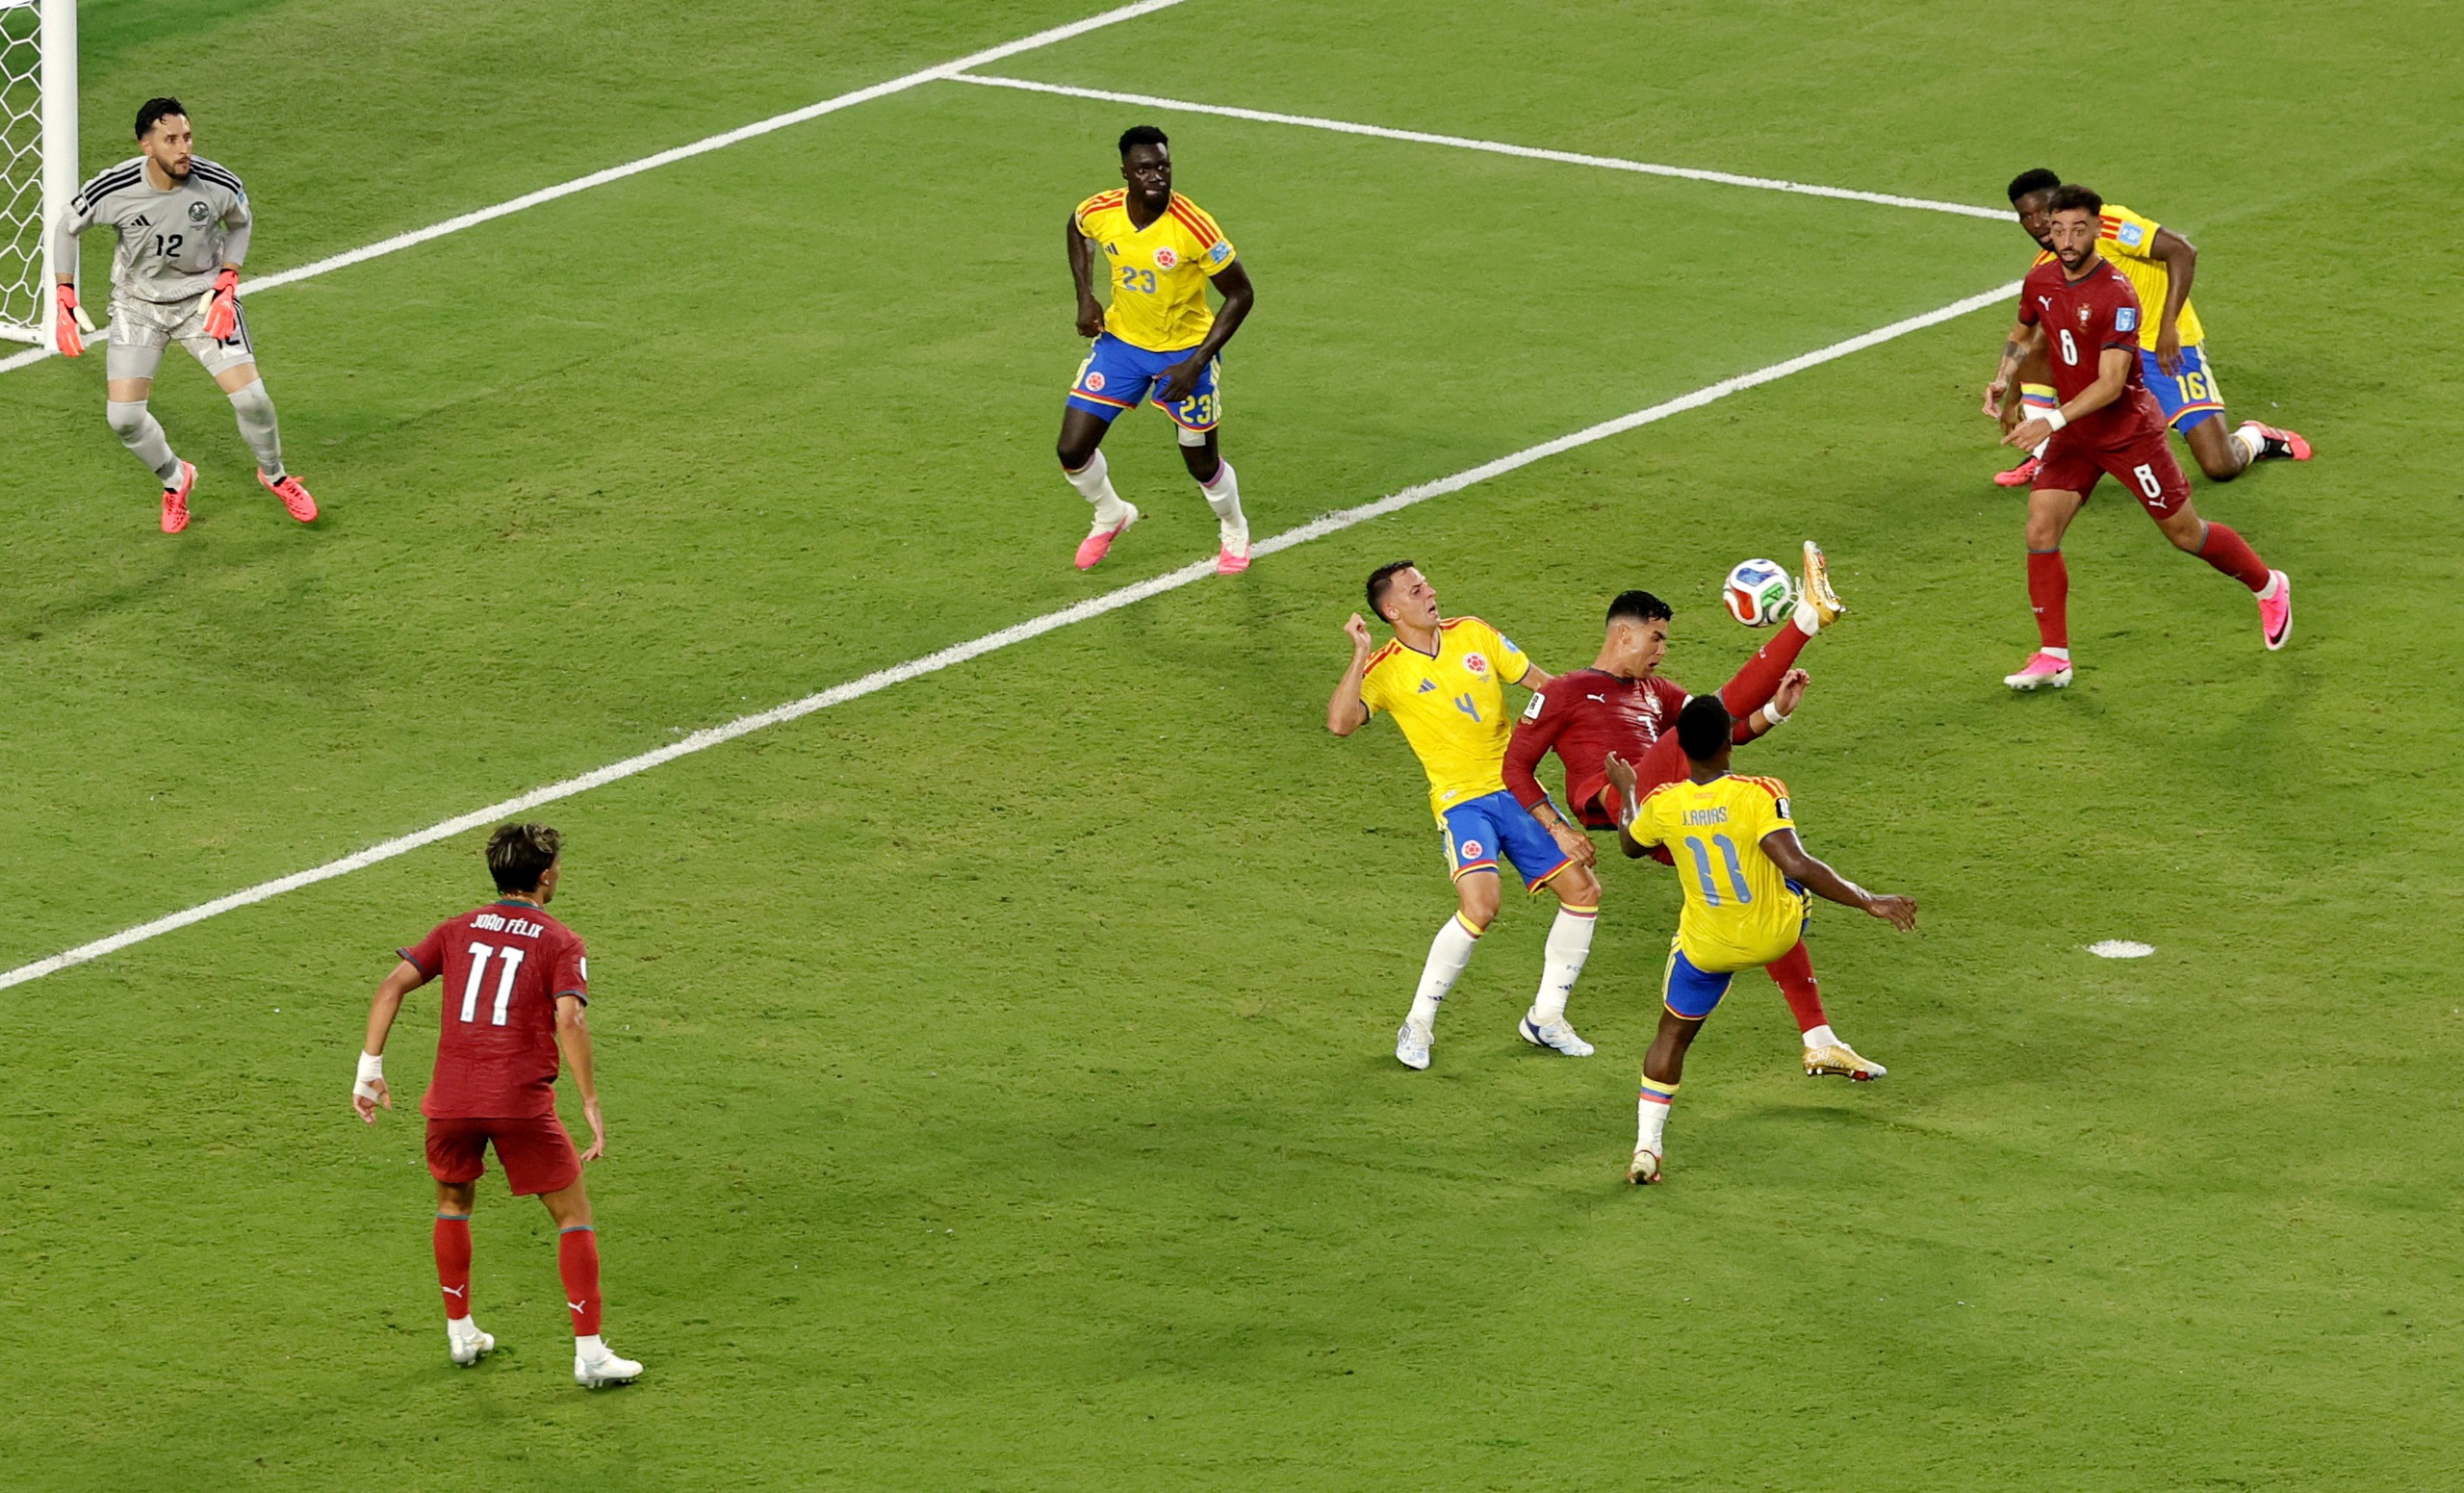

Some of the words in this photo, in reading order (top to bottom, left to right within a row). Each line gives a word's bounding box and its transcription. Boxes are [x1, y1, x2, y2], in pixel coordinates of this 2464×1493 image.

[156, 234, 183, 257] 12
[1123, 266, 1155, 294] 23
[2060, 328, 2078, 366] 8
[2176, 372, 2206, 403] 16
[1179, 395, 1211, 425] 23
[2133, 463, 2162, 499] 8
[1455, 693, 1480, 722] 4
[1637, 715, 1657, 743] 7
[1682, 807, 1728, 826] J.ARIAS
[1685, 834, 1752, 907] 11
[470, 914, 505, 932] JOÃO
[504, 917, 544, 939] FÉLIX
[460, 941, 525, 1026] 11
[1808, 1046, 1831, 1063] CR7
